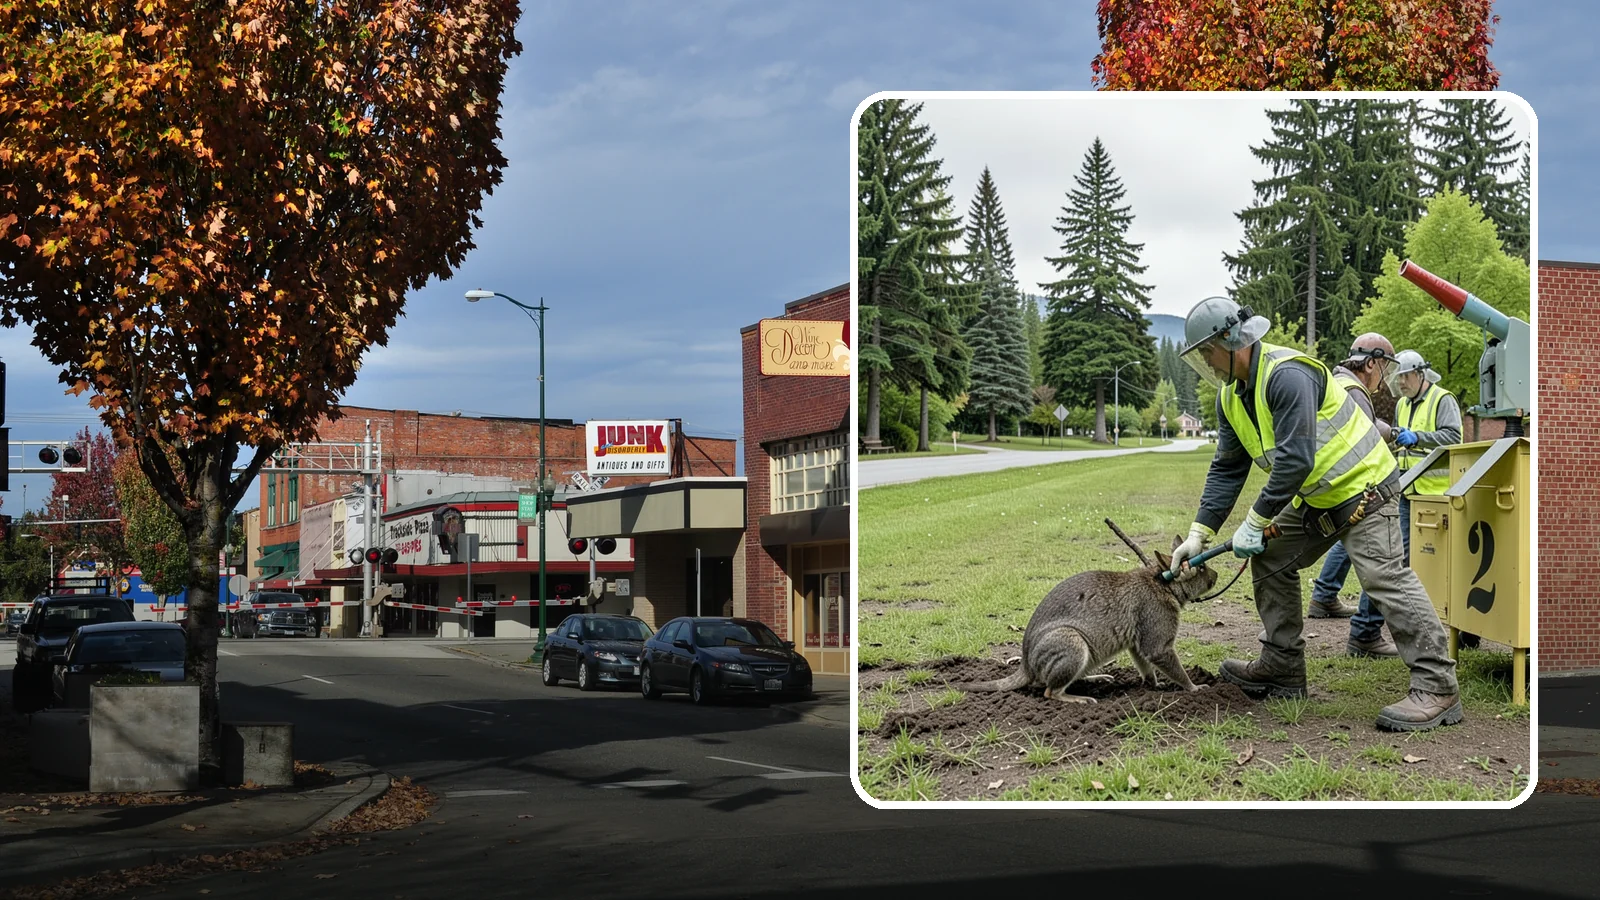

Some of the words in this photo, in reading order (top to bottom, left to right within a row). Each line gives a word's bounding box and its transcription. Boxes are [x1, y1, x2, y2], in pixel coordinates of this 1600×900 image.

[595, 425, 665, 457] JUNK
[607, 446, 646, 454] DISORDERLY
[597, 461, 628, 470] ANTIQUES
[631, 461, 644, 470] AND
[647, 460, 665, 470] GIFTS
[573, 473, 588, 491] RAIL
[352, 498, 365, 511] CRO
[390, 522, 413, 539] Trackside
[414, 519, 429, 535] Pizza
[1466, 520, 1496, 615] 2
